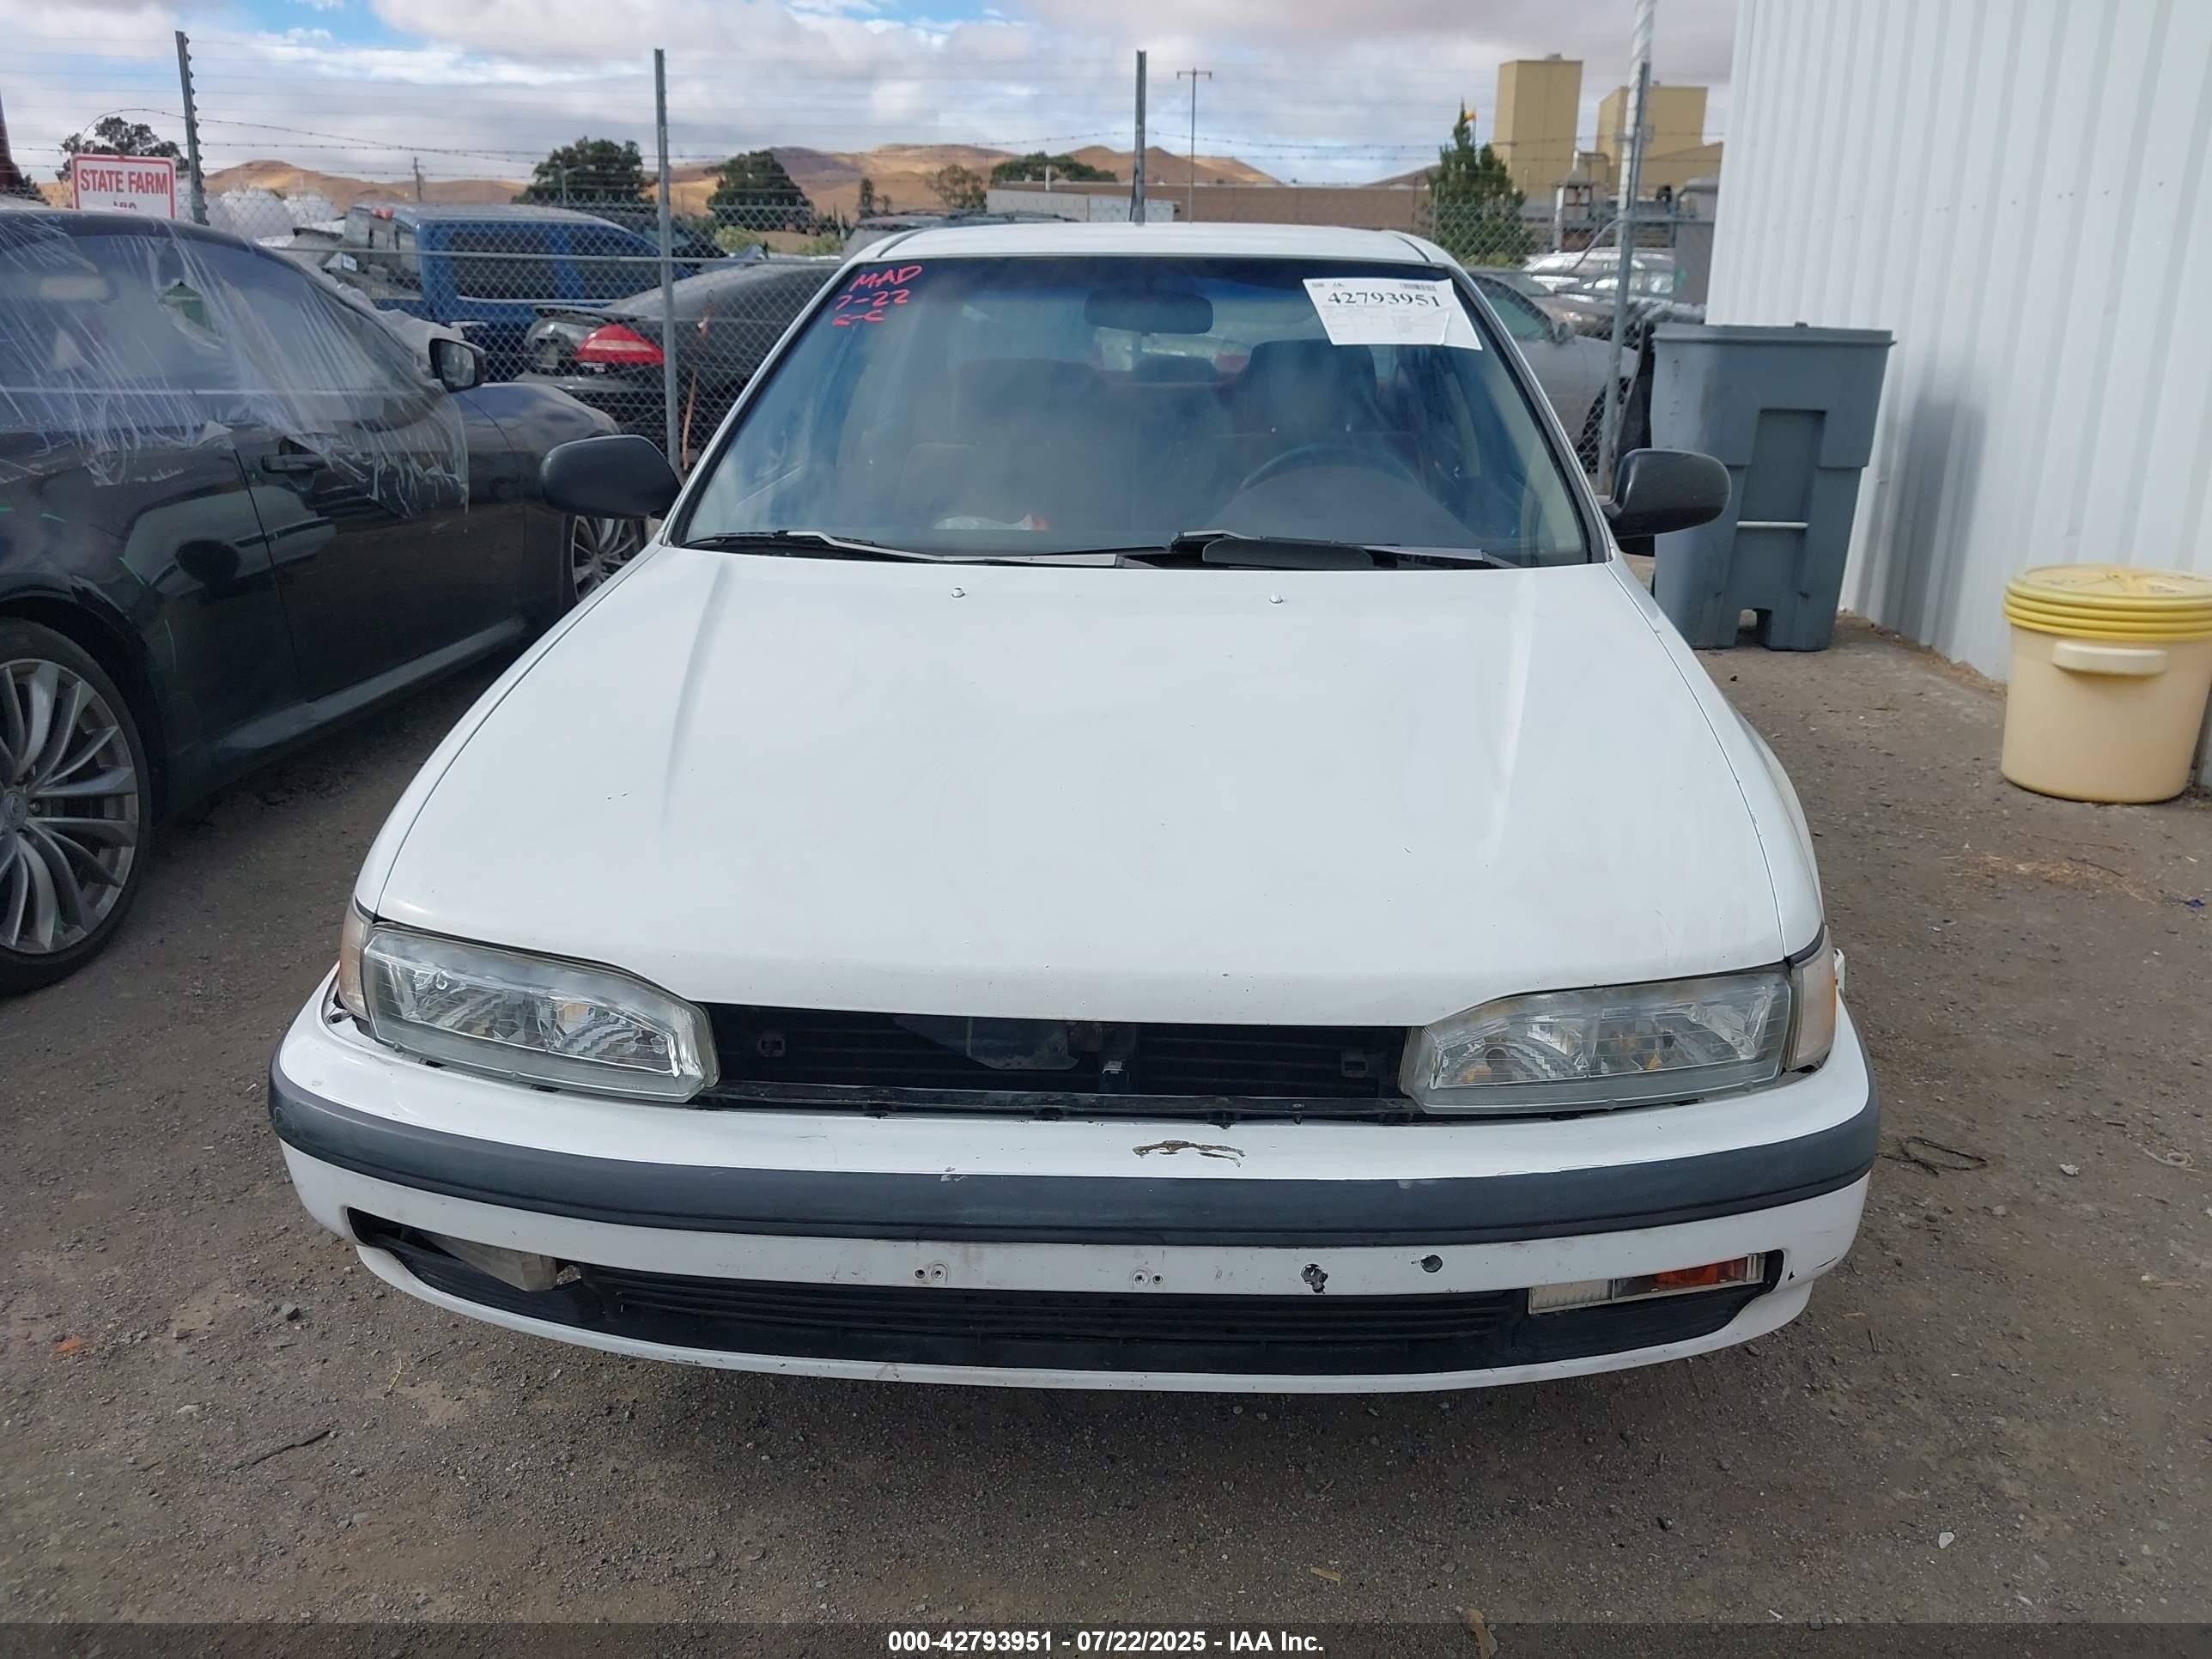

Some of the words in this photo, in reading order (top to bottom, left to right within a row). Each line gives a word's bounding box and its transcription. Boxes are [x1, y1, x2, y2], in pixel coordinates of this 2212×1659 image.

[81, 168, 125, 192] STATE
[128, 171, 168, 195] FARM
[849, 264, 923, 292] MAD
[1328, 291, 1441, 307] 42793951
